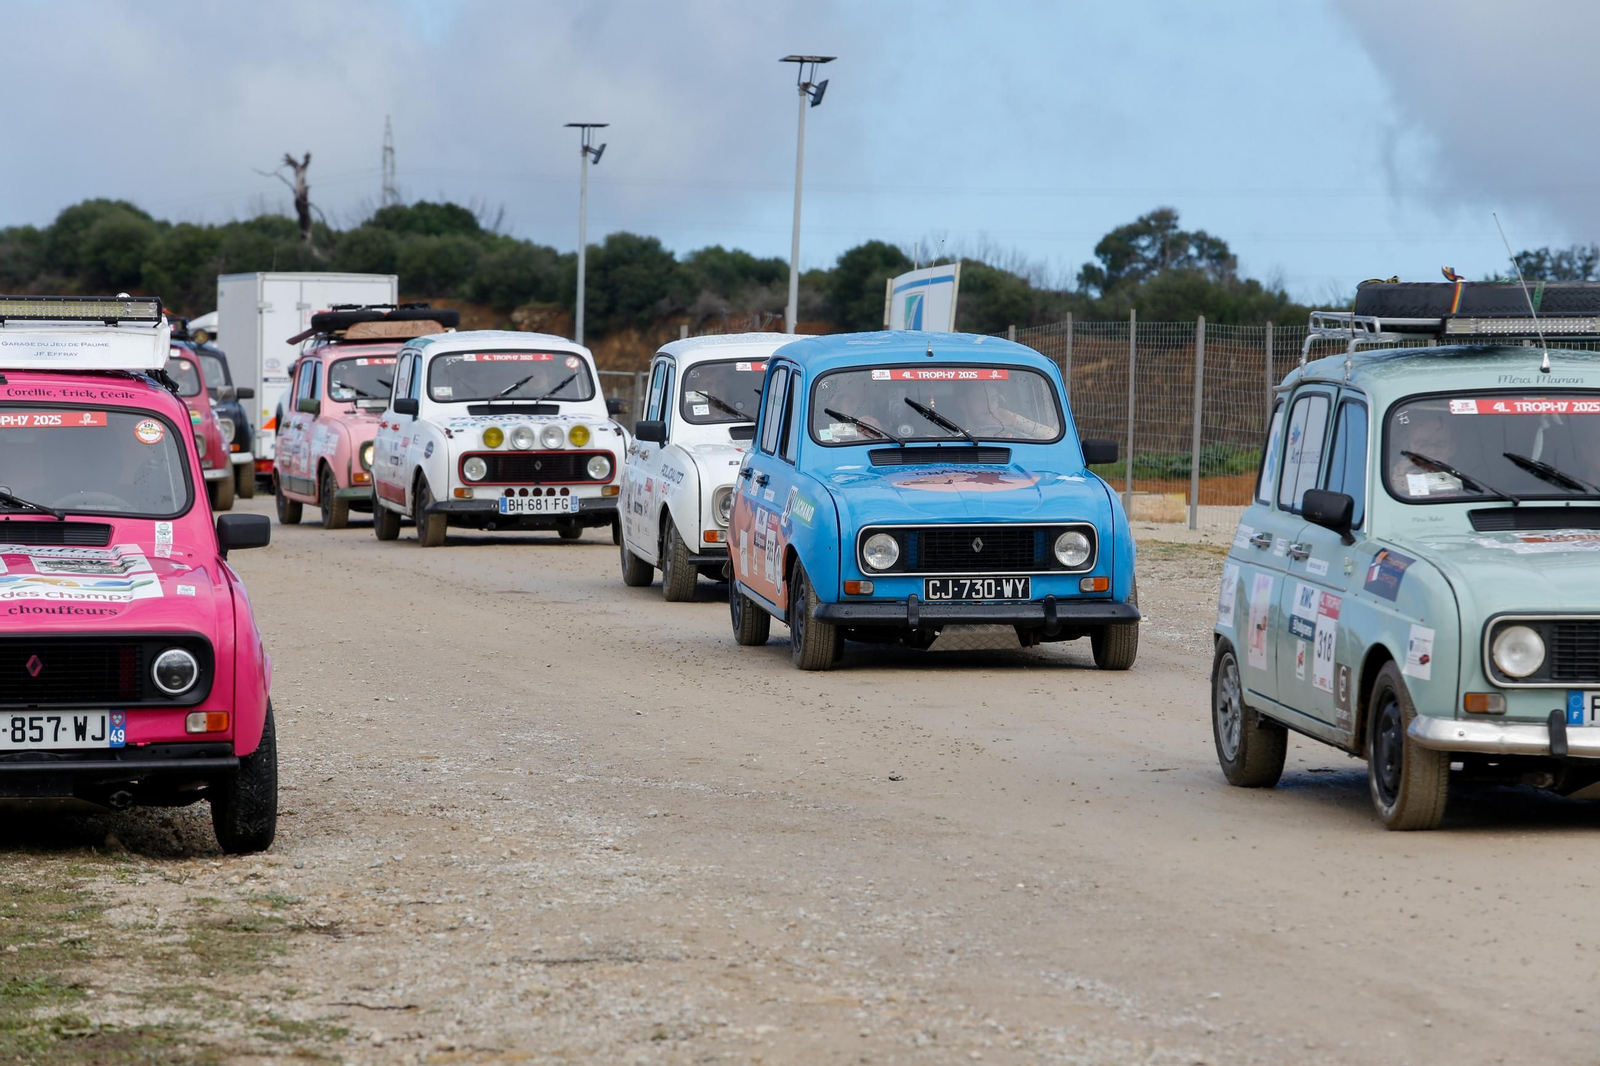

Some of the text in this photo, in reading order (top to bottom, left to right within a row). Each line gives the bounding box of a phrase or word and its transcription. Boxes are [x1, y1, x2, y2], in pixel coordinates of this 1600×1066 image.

[902, 371, 979, 380] 4L TROPHY 2025
[1498, 374, 1585, 384] Merci Maman
[1493, 402, 1600, 413] 4L TROPHY 2025
[0, 414, 63, 426] PHY 2025
[508, 498, 569, 511] BH-681-FG
[929, 579, 1026, 599] CJ-730-WY
[1, 590, 133, 602] des Champs
[1317, 630, 1333, 662] 318
[1573, 711, 1580, 720] F
[110, 729, 125, 743] 49
